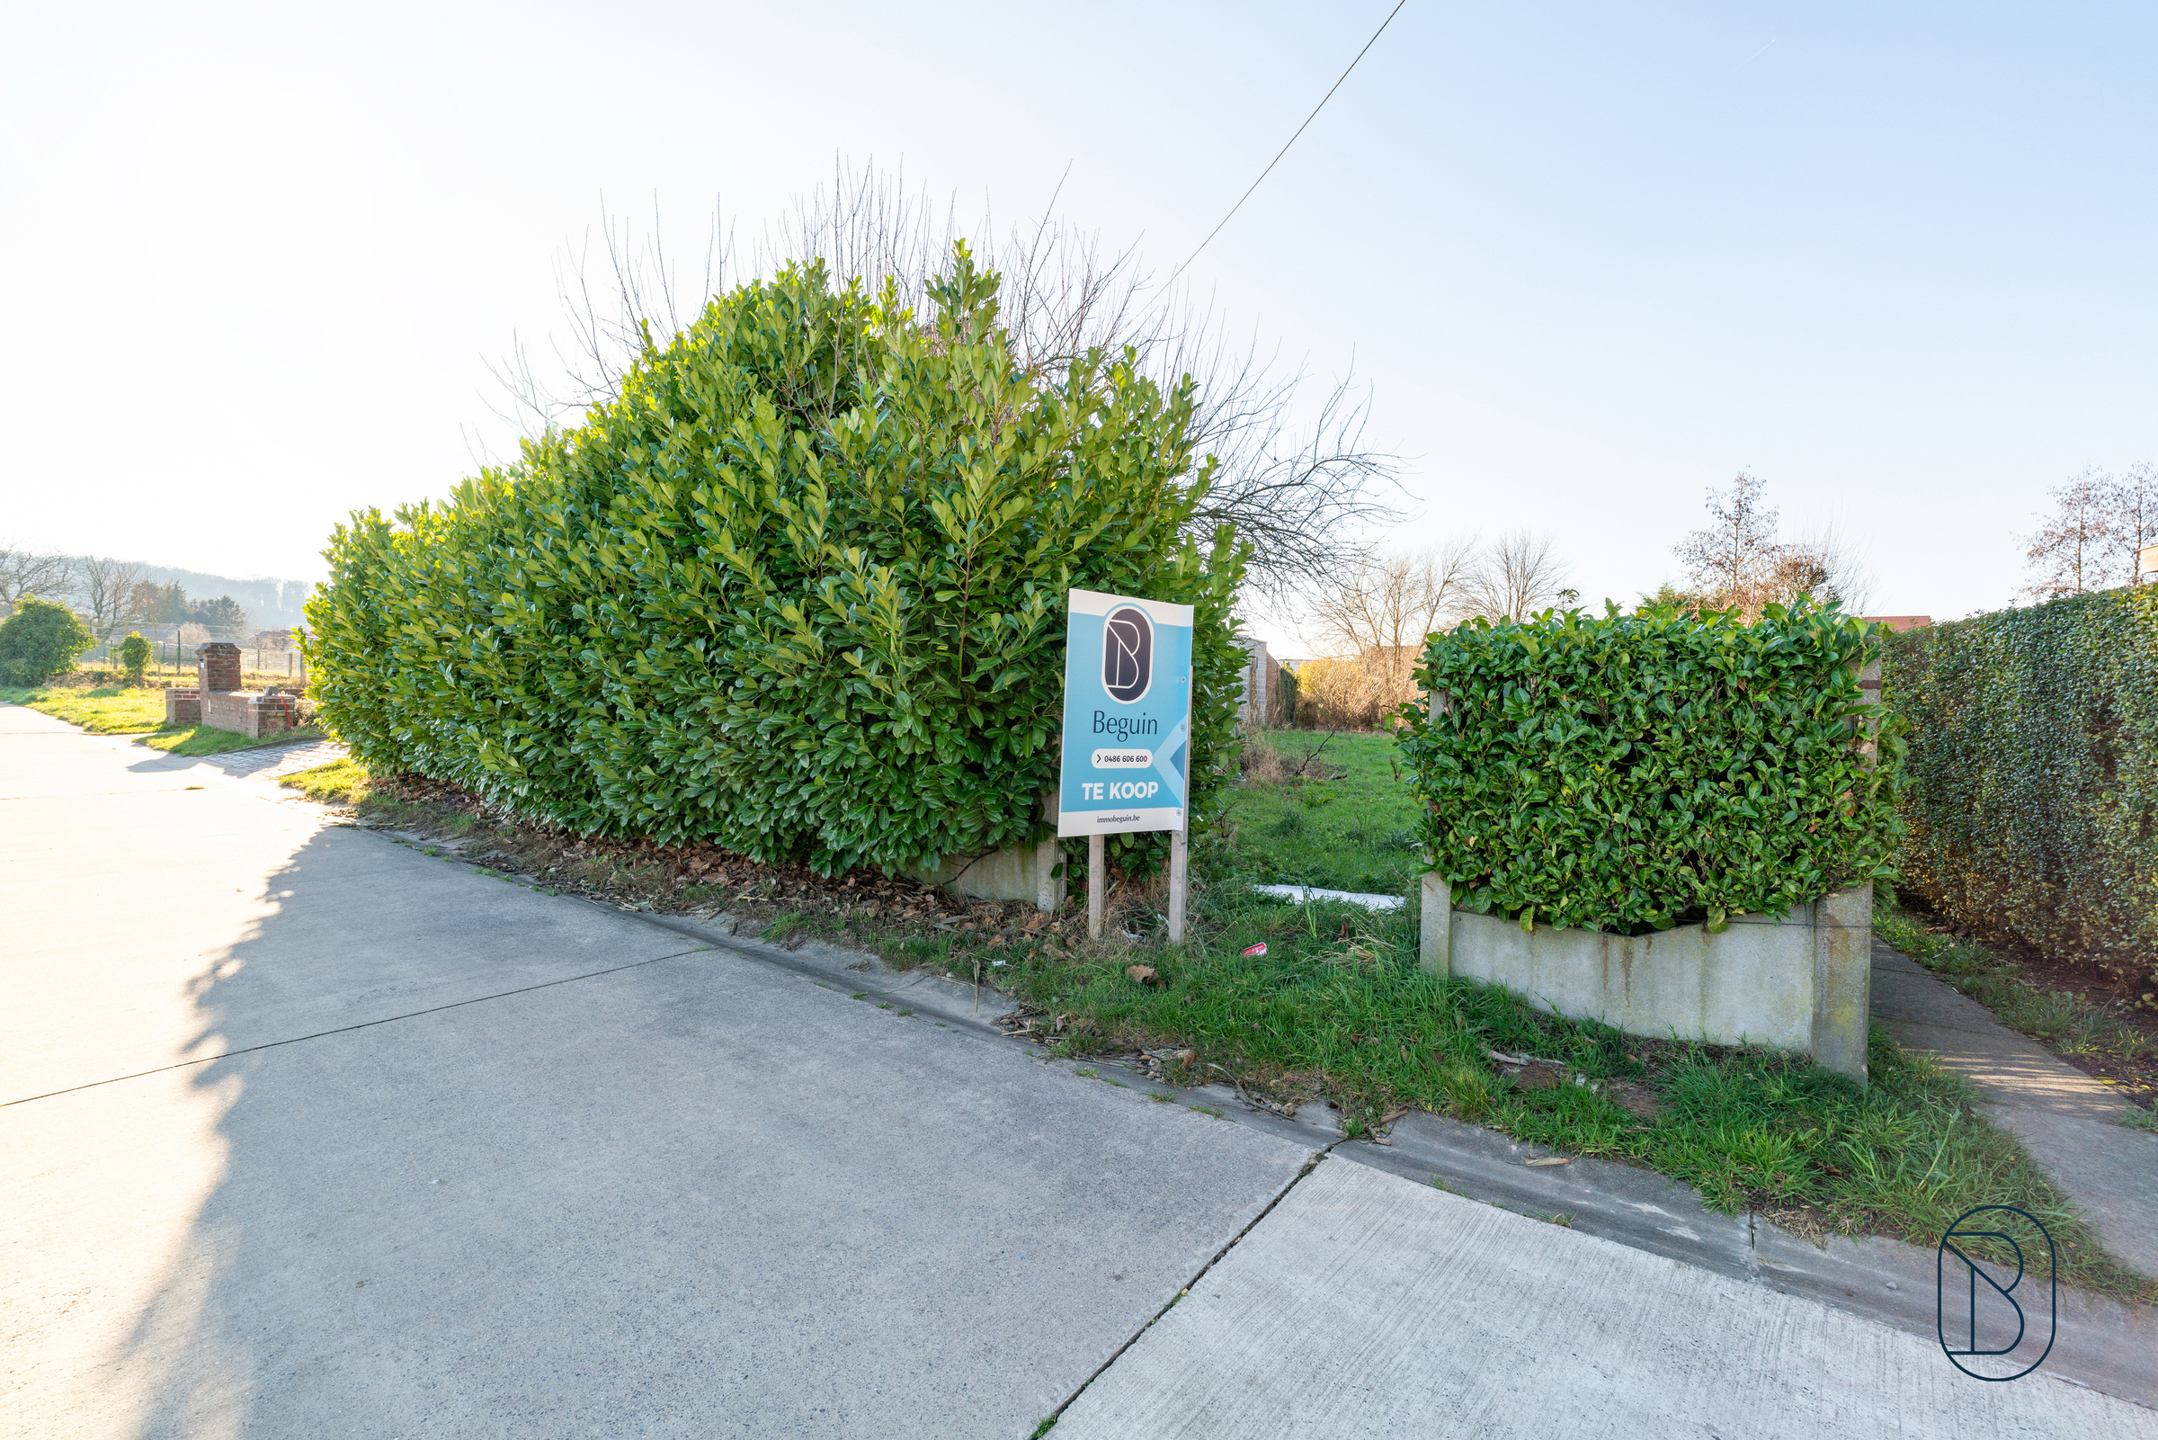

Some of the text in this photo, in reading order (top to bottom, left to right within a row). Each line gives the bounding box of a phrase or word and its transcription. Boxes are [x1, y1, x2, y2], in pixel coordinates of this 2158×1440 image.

[1093, 710, 1158, 742] Beguin
[1104, 755, 1148, 763] 0486 606 600
[1082, 781, 1159, 801] TE KOOP
[1097, 814, 1140, 824] immobeguin.be
